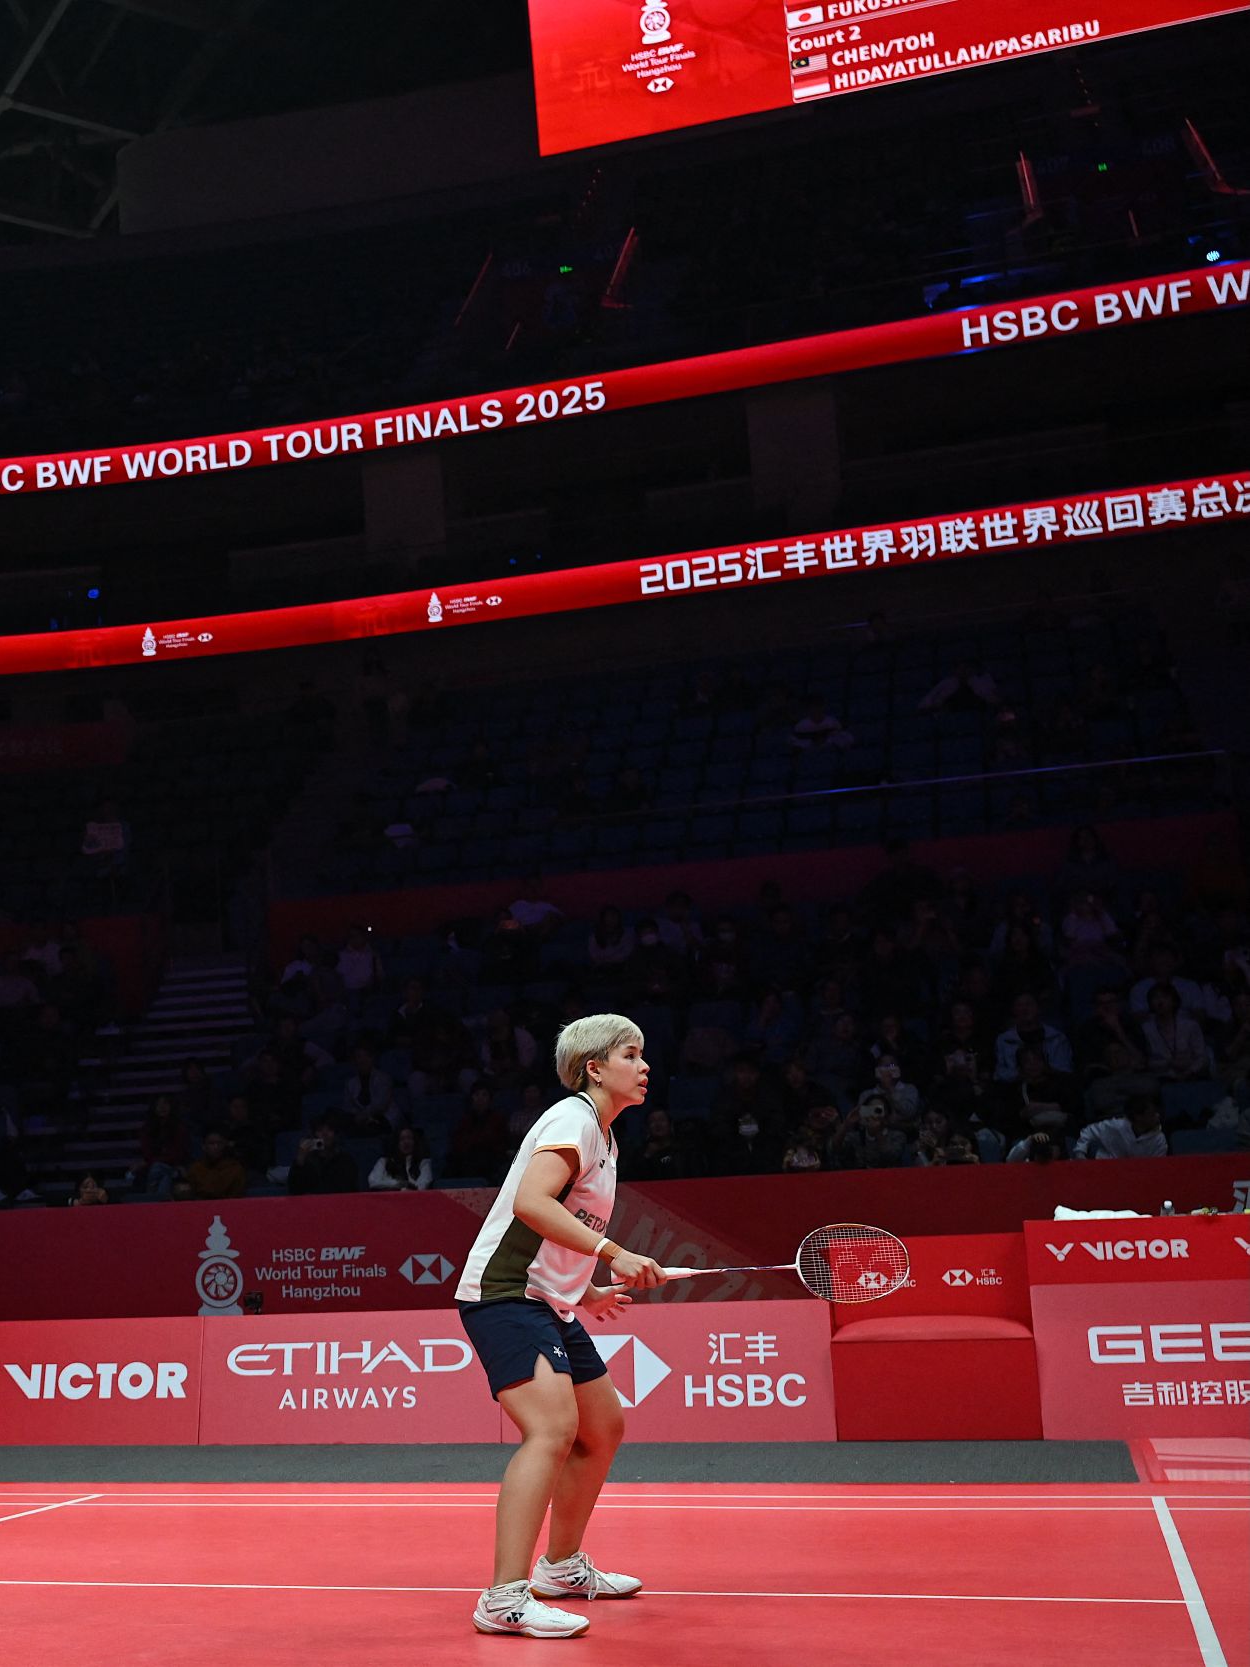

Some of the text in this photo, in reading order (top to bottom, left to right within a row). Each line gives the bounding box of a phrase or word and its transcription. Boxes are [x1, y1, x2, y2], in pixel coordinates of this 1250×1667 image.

[789, 25, 862, 52] Court 2
[831, 31, 935, 67] CHEN/TOH
[833, 19, 1100, 90] HIDAYATULLAH/PASARIBU
[961, 301, 1080, 348] HSBC
[1095, 279, 1191, 325] BWF
[36, 455, 110, 488] BWF
[122, 439, 251, 479] WORLD
[263, 422, 363, 462] TOUR
[375, 399, 503, 446] FINALS
[515, 381, 606, 423] 2025
[272, 1246, 366, 1262] HSBC BWF
[1081, 1238, 1190, 1261] VICTOR
[255, 1263, 387, 1281] World Tour Finals
[976, 1276, 1003, 1286] HSBC
[281, 1282, 361, 1299] Hangzhou
[226, 1338, 473, 1376] ETIHAD
[707, 1331, 779, 1365] 汇丰
[4, 1361, 188, 1400] VICTOR
[278, 1385, 417, 1410] AIRWAYS
[684, 1373, 807, 1408] HSBC
